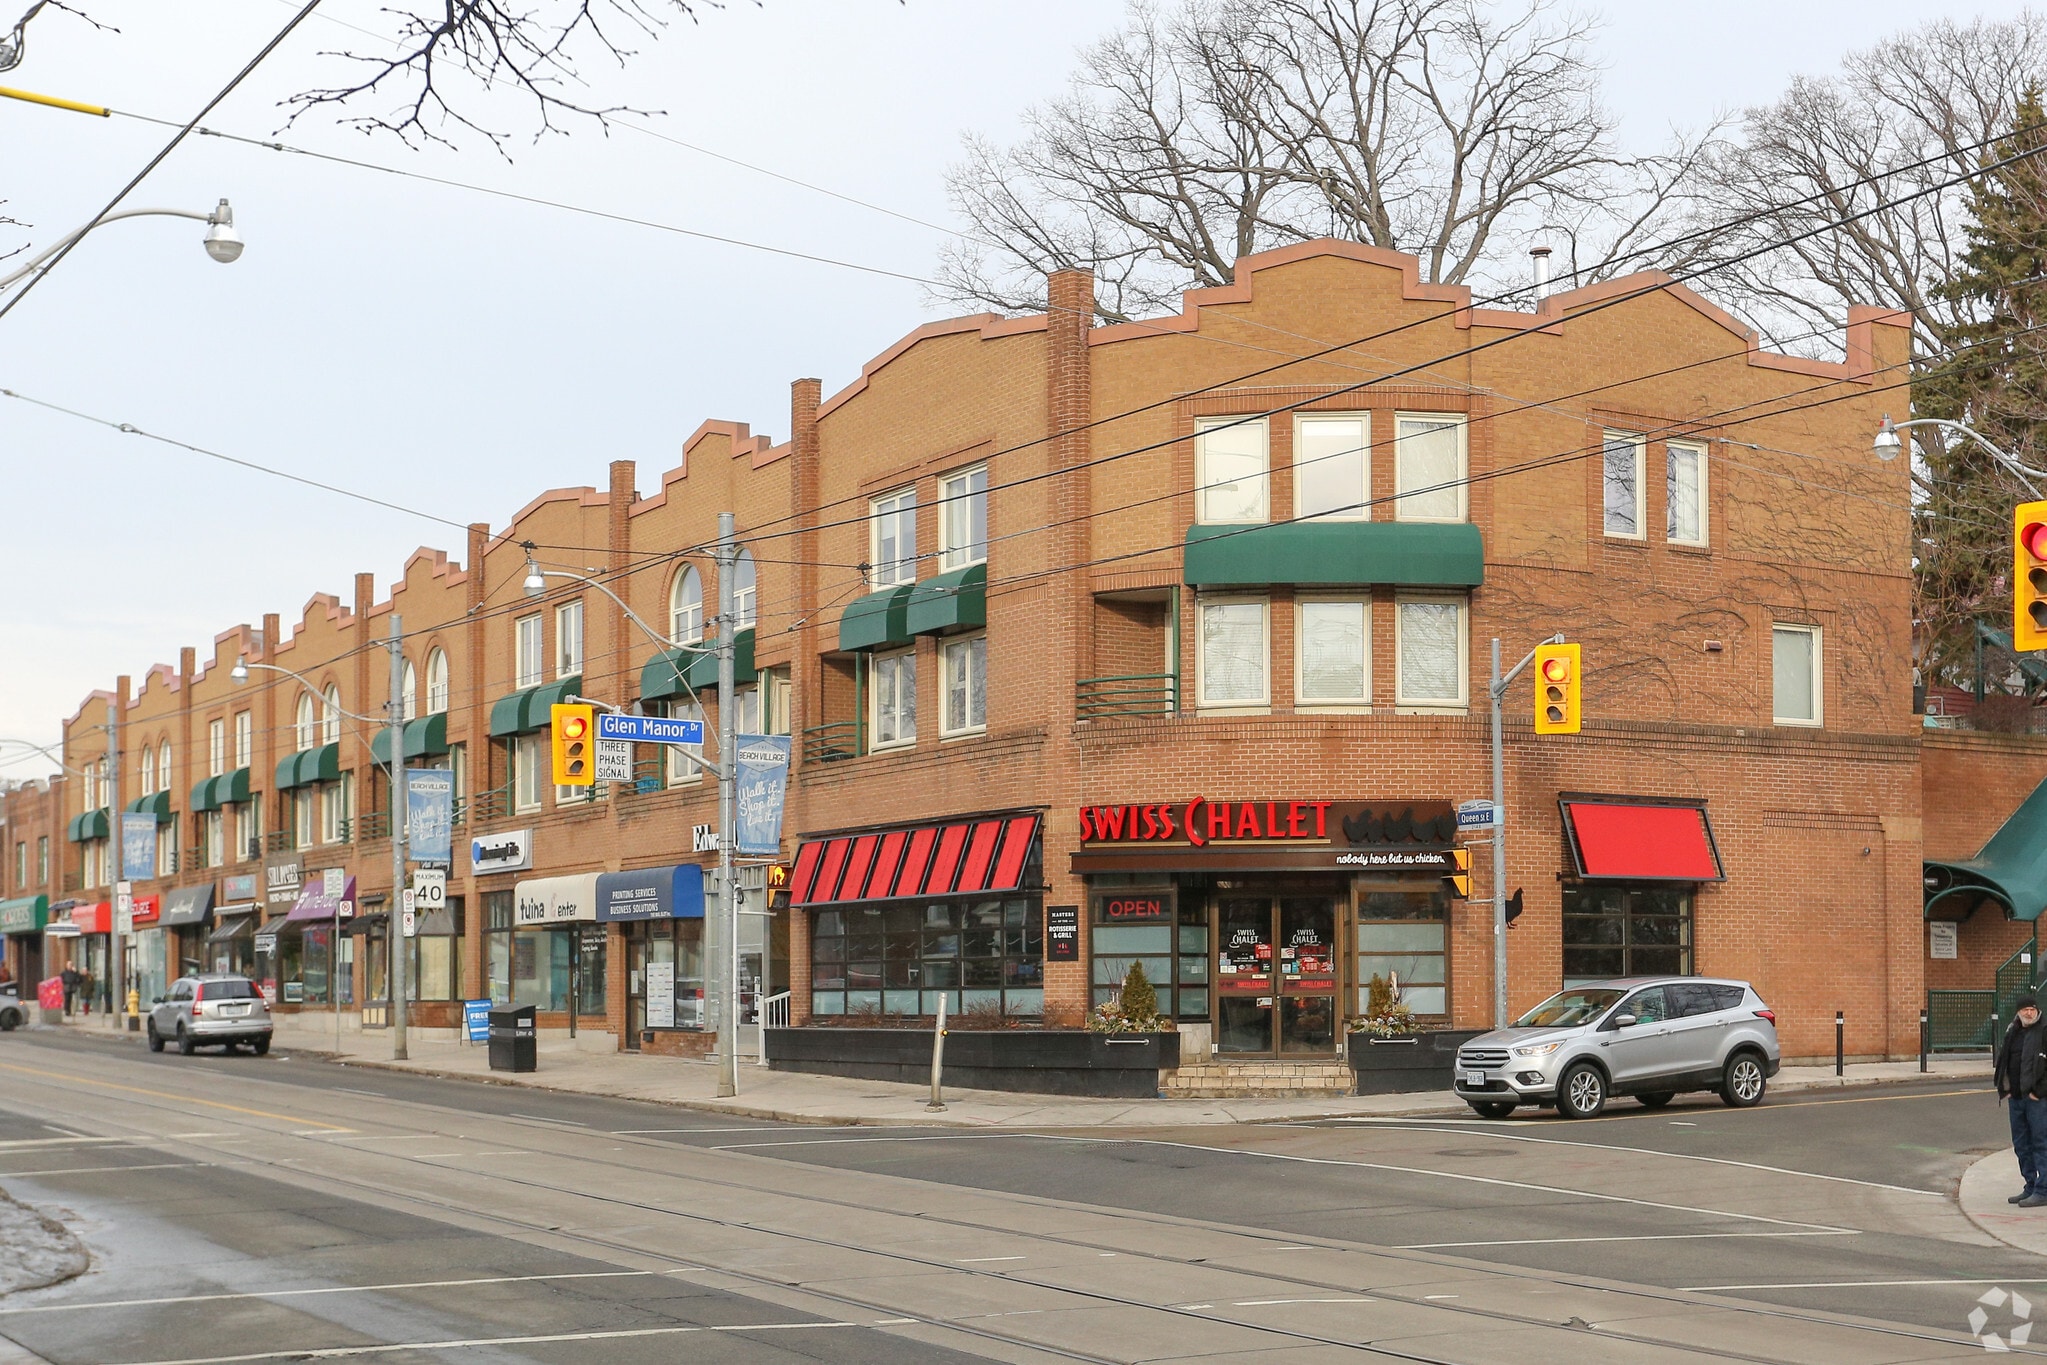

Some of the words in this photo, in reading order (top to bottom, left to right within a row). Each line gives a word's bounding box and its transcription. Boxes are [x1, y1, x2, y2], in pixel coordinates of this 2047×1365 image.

[604, 717, 636, 734] Glen
[643, 719, 685, 737] Manor
[690, 723, 699, 731] Dr
[600, 742, 626, 752] THREE
[599, 755, 626, 765] PHASE
[739, 751, 758, 760] BEACH
[760, 752, 785, 762] VILLAGE
[598, 767, 628, 778] SIGNAL
[738, 781, 766, 801] Walk
[740, 797, 765, 816] Shop
[1079, 804, 1176, 841] SWISS
[1184, 796, 1332, 847] CHALET
[1461, 813, 1480, 823] Queen
[1486, 812, 1490, 821] E
[1336, 852, 1368, 866] nobody
[1369, 853, 1387, 864] here
[1388, 853, 1403, 864] but
[1404, 855, 1414, 864] us
[418, 885, 442, 901] 40
[612, 890, 634, 899] PRINTING
[634, 887, 657, 898] SERVICES
[520, 897, 545, 920] tuina
[610, 905, 631, 915] BUSINESS
[632, 903, 658, 913] SOLUTIONS
[1109, 900, 1160, 917] OPEN
[1232, 934, 1259, 944] CHALET
[1292, 934, 1319, 944] CHALET
